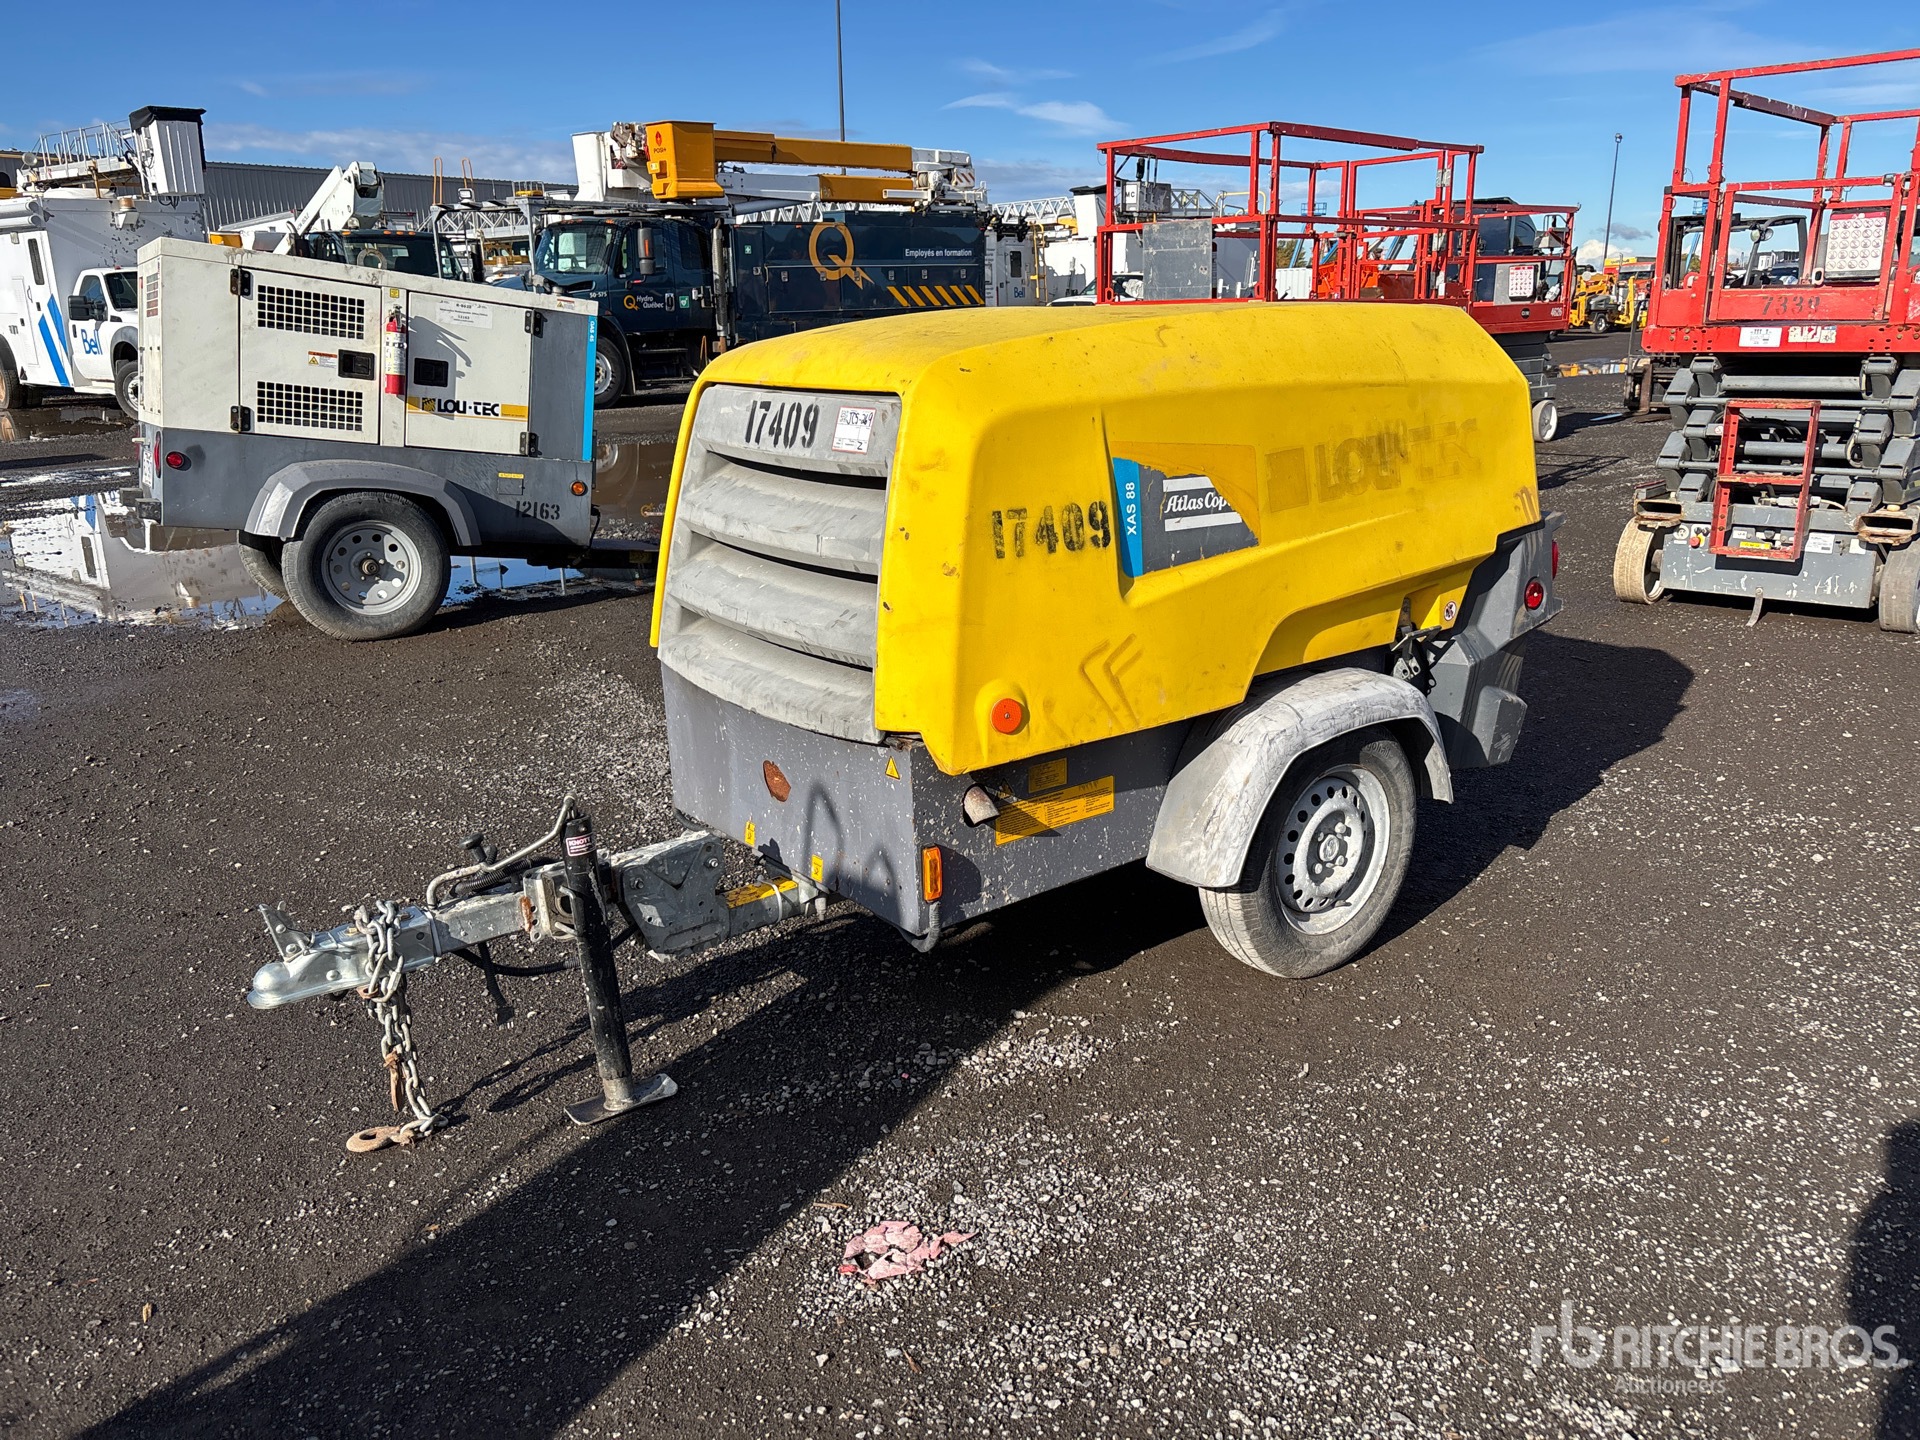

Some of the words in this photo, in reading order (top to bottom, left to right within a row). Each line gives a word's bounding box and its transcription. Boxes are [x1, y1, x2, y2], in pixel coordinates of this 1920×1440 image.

[905, 248, 935, 258] Employés
[944, 248, 973, 257] formation
[636, 295, 654, 303] Hydro
[1013, 286, 1026, 299] Bell
[642, 301, 664, 309] Québec
[80, 329, 103, 355] Bell
[744, 400, 820, 449] 17409
[1125, 481, 1136, 502] 88
[515, 500, 561, 521] 12163
[1164, 493, 1204, 514] Atlas
[991, 500, 1112, 560] 17409
[1126, 504, 1138, 536] XAS
